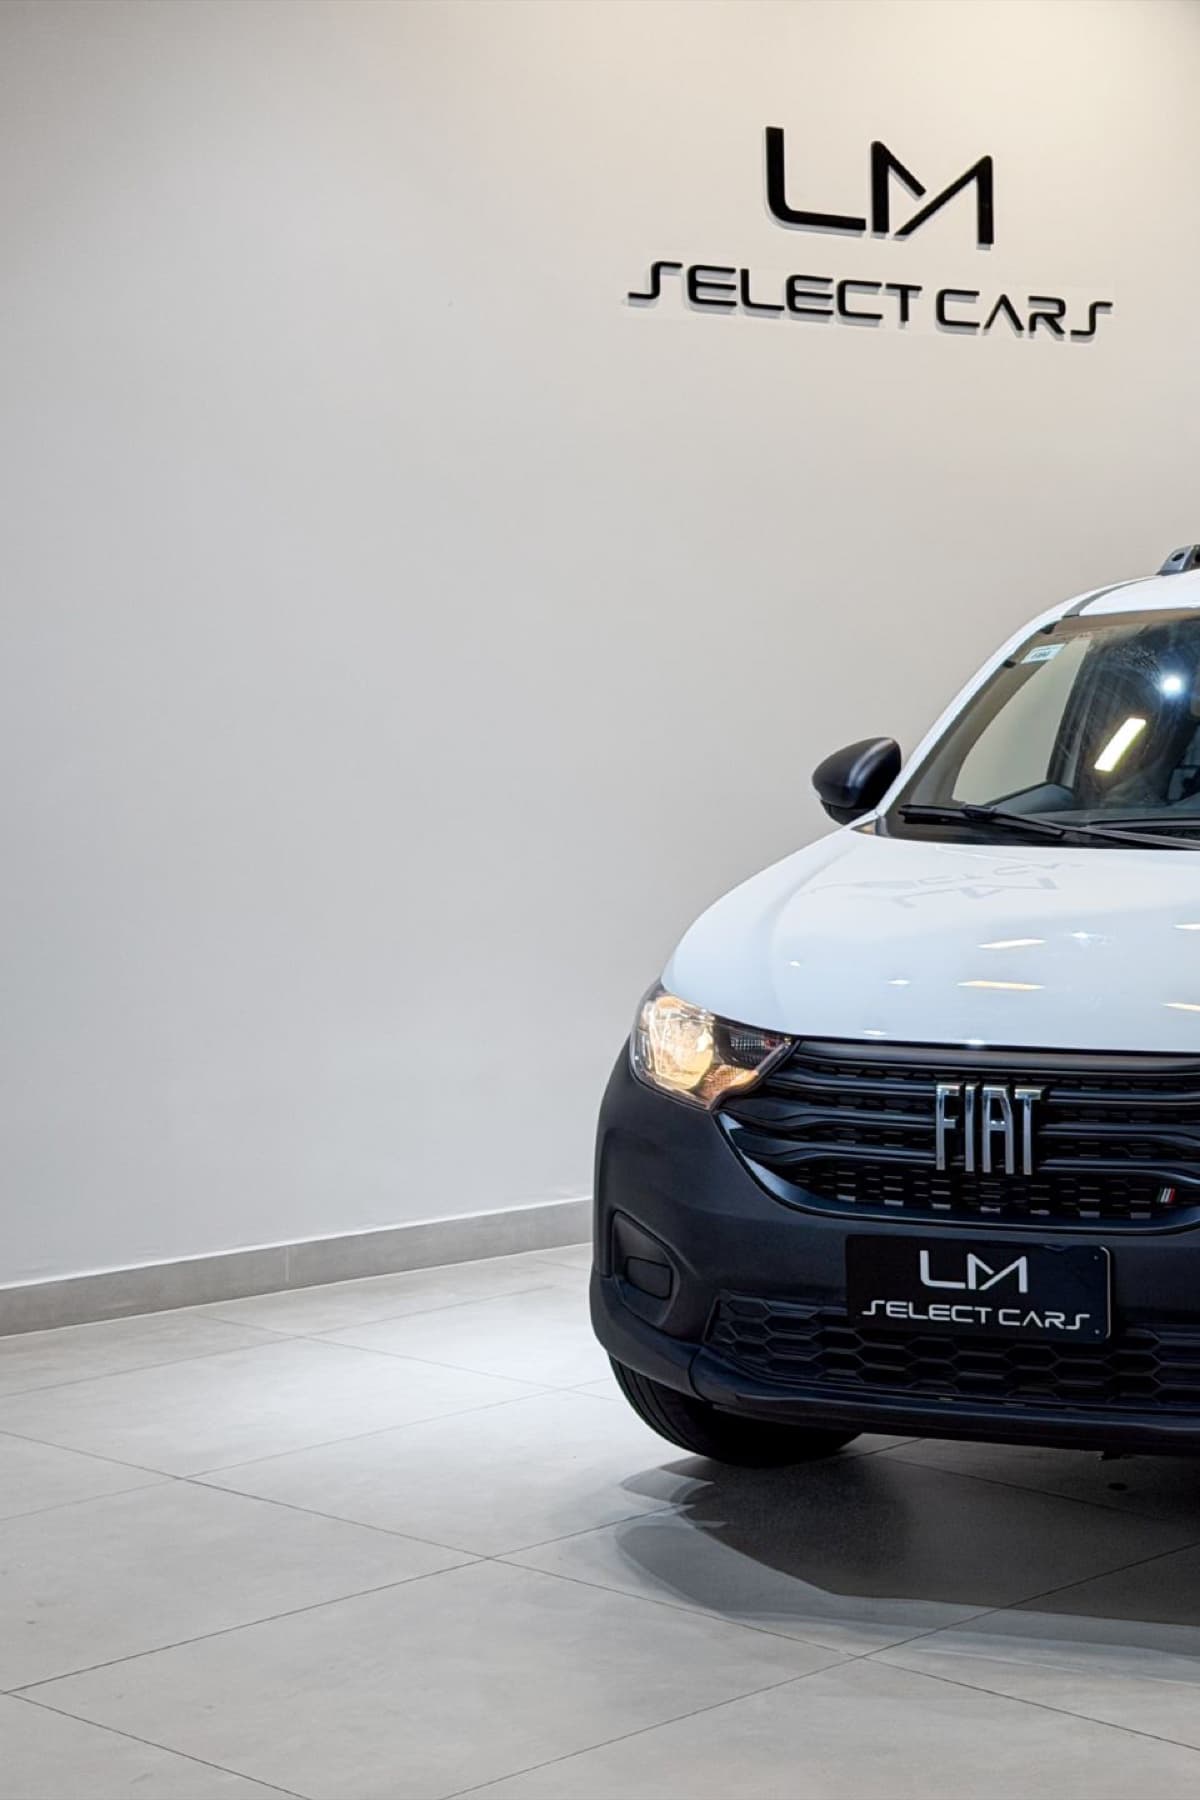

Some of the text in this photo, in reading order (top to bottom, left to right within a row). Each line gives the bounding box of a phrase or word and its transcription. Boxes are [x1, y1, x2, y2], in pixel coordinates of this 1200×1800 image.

[765, 126, 994, 245] LM
[628, 261, 1112, 336] SELECT CARS
[936, 1083, 1043, 1175] FIAT
[920, 1250, 1028, 1293] LM
[862, 1300, 1090, 1330] SELECT CARS
